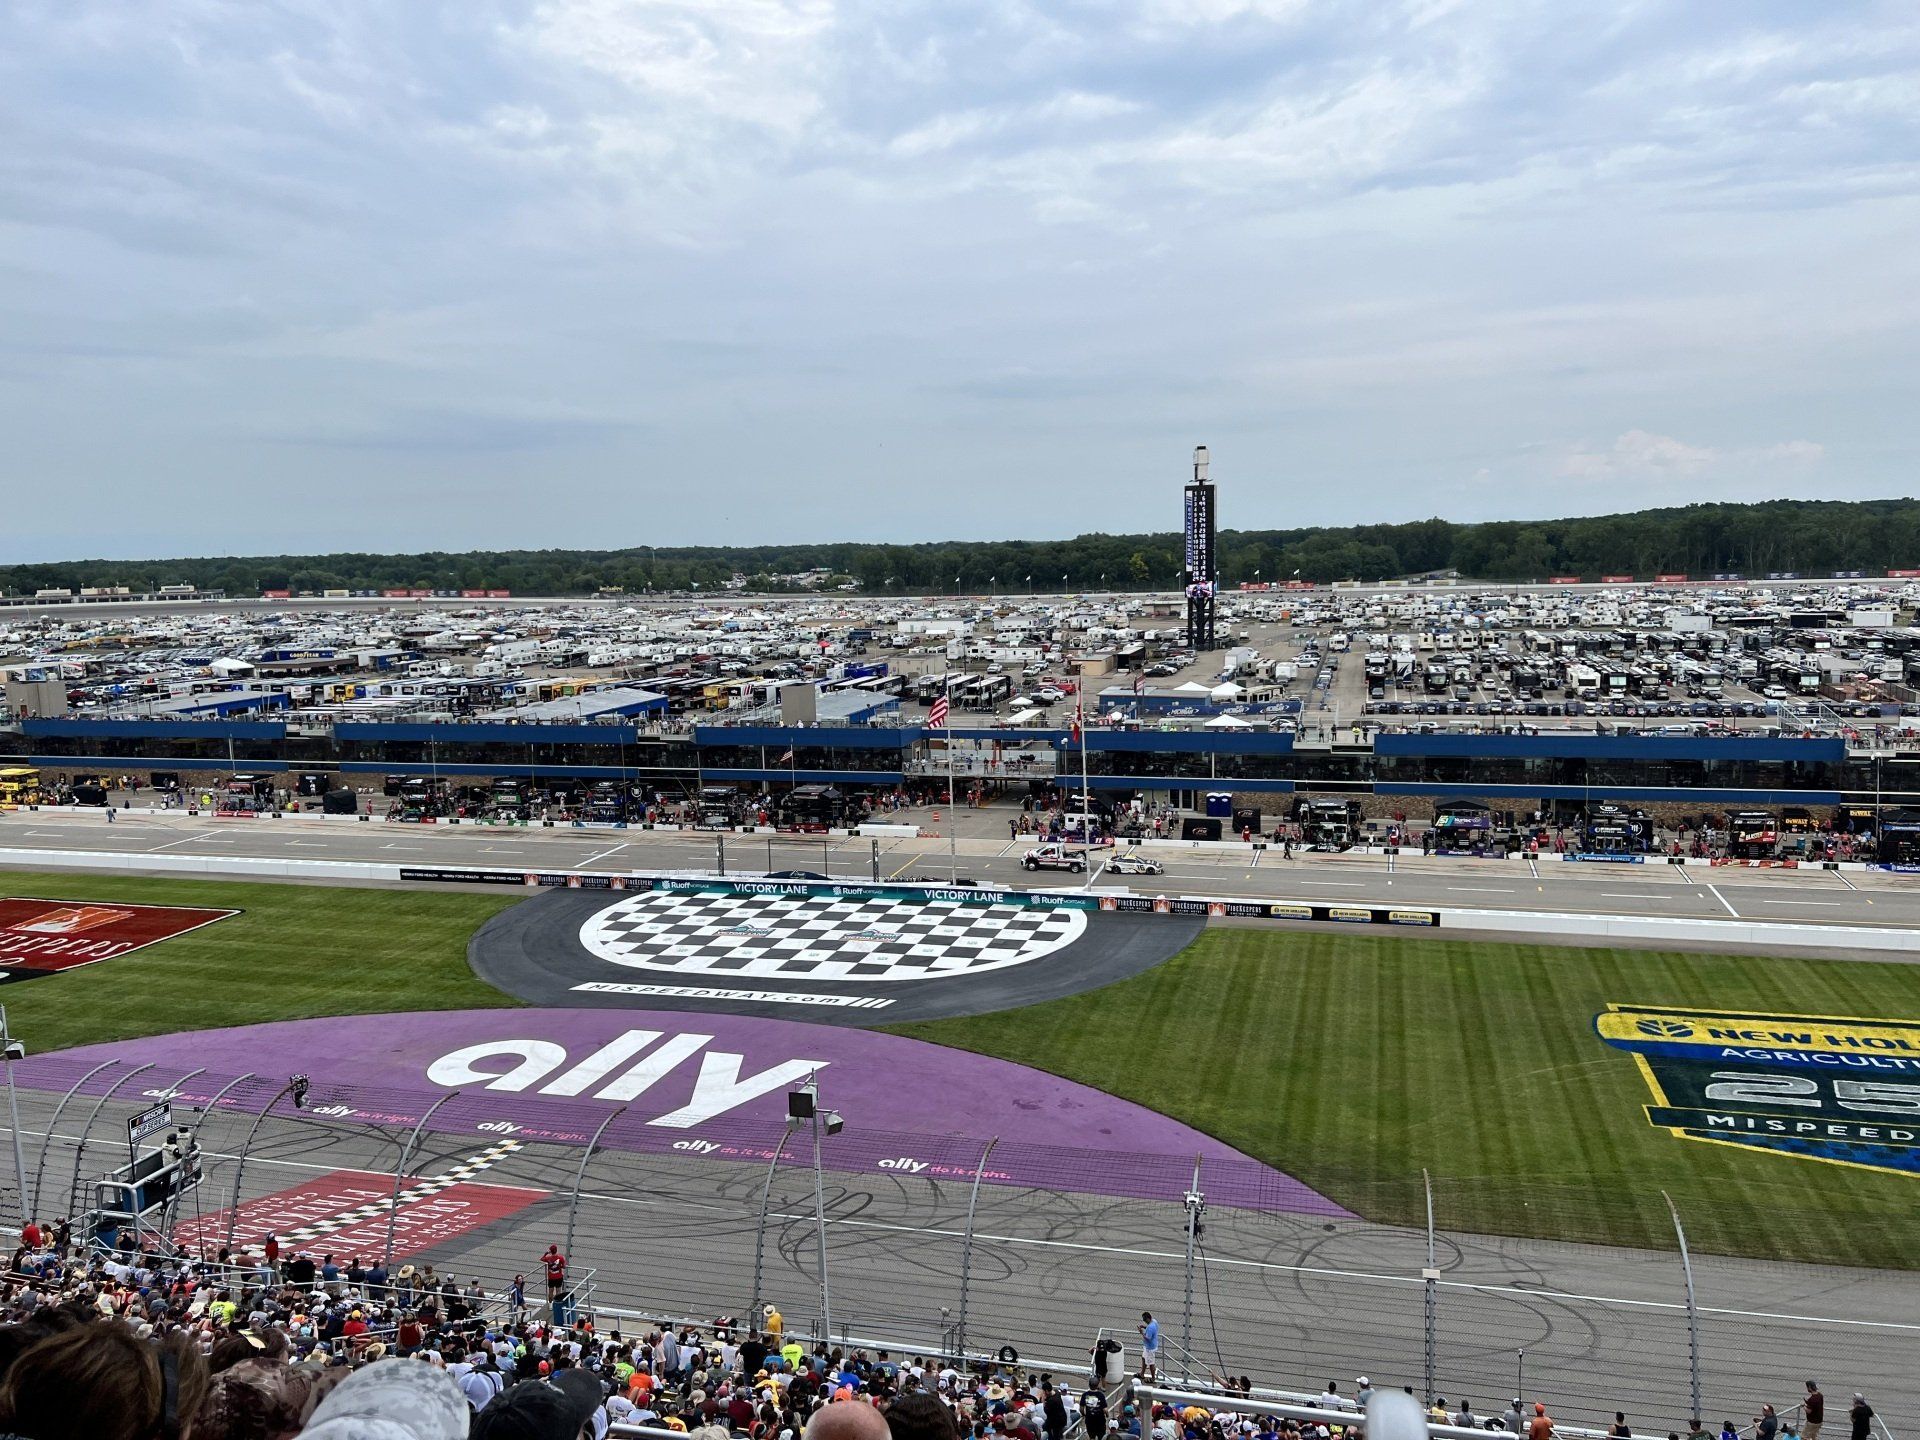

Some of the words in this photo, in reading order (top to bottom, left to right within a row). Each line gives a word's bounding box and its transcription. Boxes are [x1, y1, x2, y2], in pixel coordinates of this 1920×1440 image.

[734, 883, 777, 894] VICTORY
[780, 885, 808, 895] LANE
[924, 889, 972, 900] VICTORY
[974, 892, 1003, 902] LANE
[1041, 896, 1063, 904] Ruoff
[1117, 899, 1150, 908] FIREKEEPERS
[1170, 902, 1205, 910] FIREKEEPERS
[1224, 904, 1262, 913] FIREKEEPERS
[588, 984, 842, 1004] MISPEEDWAY.com
[1708, 1028, 1812, 1044] NEW
[426, 1029, 832, 1128] ally
[143, 1106, 164, 1119] NASCAR
[313, 1105, 357, 1118] ally
[477, 1121, 522, 1135] ally
[1706, 1115, 1915, 1141] MISPEED
[672, 1139, 722, 1154] ally
[877, 1157, 929, 1173] ally
